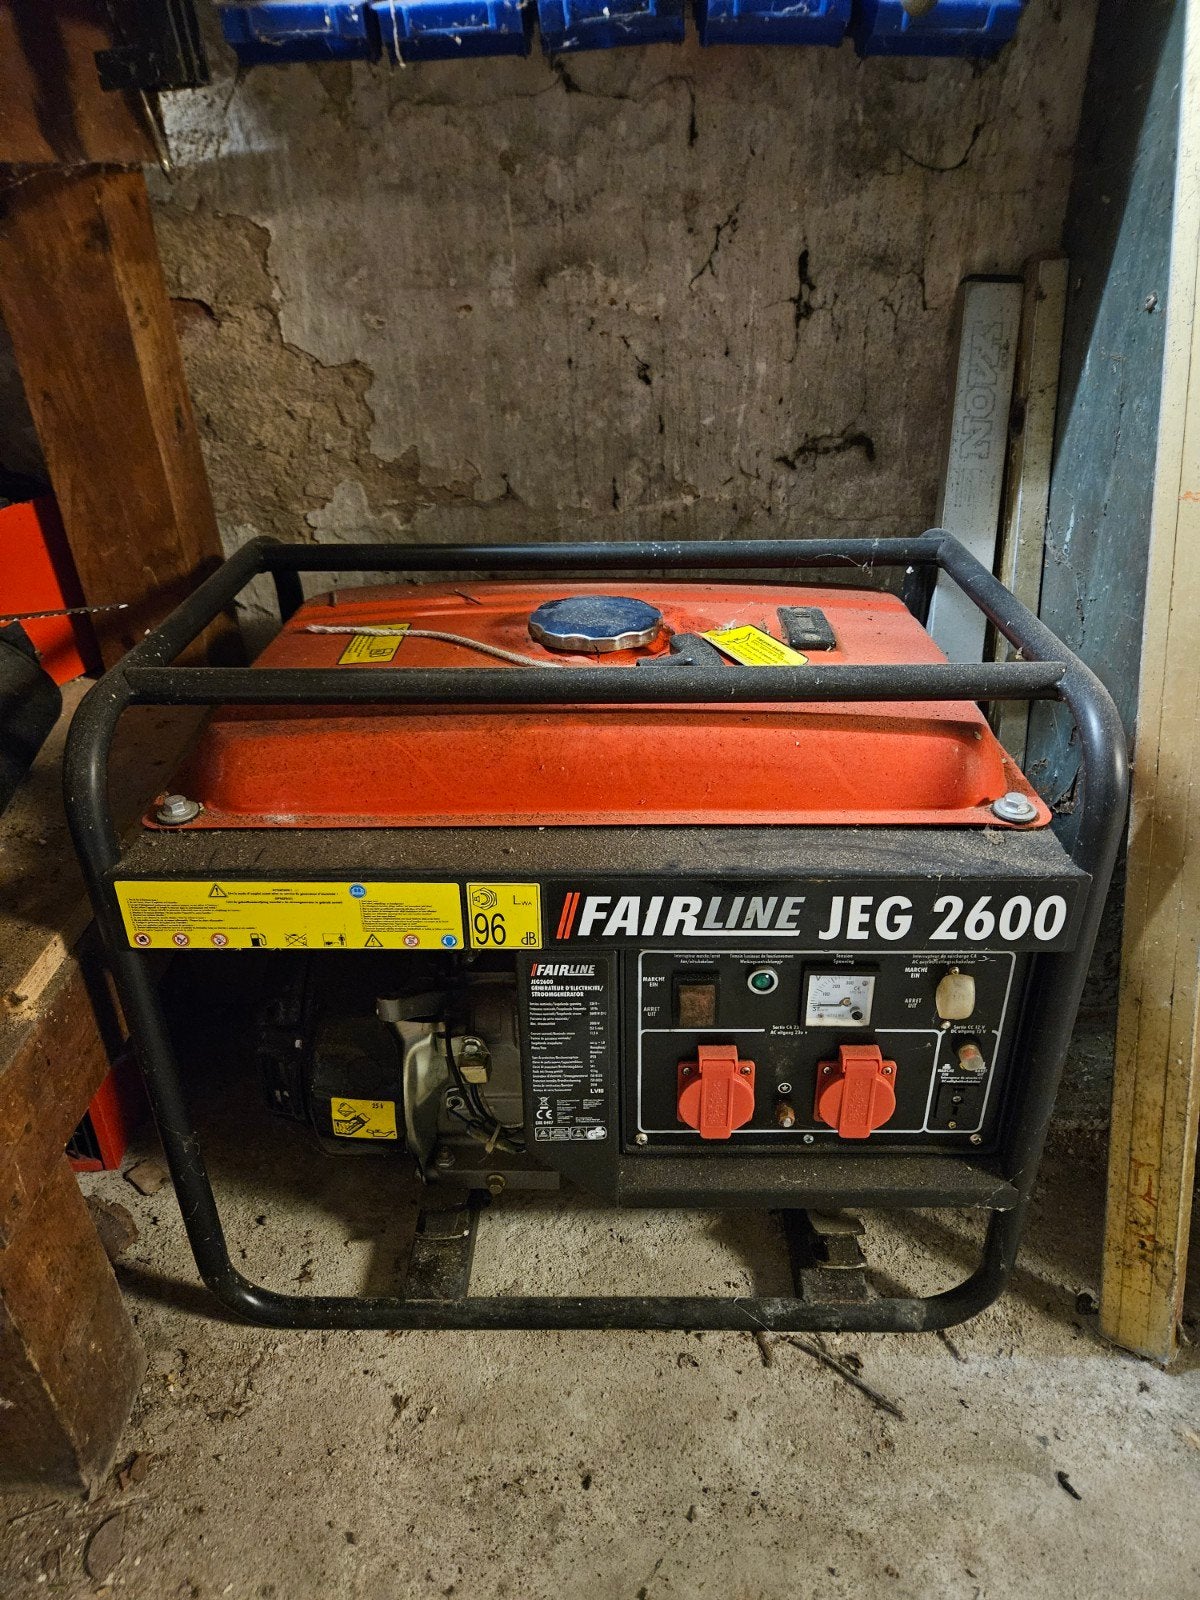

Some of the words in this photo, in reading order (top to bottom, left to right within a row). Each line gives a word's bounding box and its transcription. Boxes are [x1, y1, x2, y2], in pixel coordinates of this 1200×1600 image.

[474, 912, 506, 946] 96
[577, 895, 804, 936] FAIRLINE
[818, 895, 912, 941] JEG
[928, 895, 1067, 941] 2600
[521, 931, 537, 945] dB
[536, 964, 595, 976] FAIRLINE
